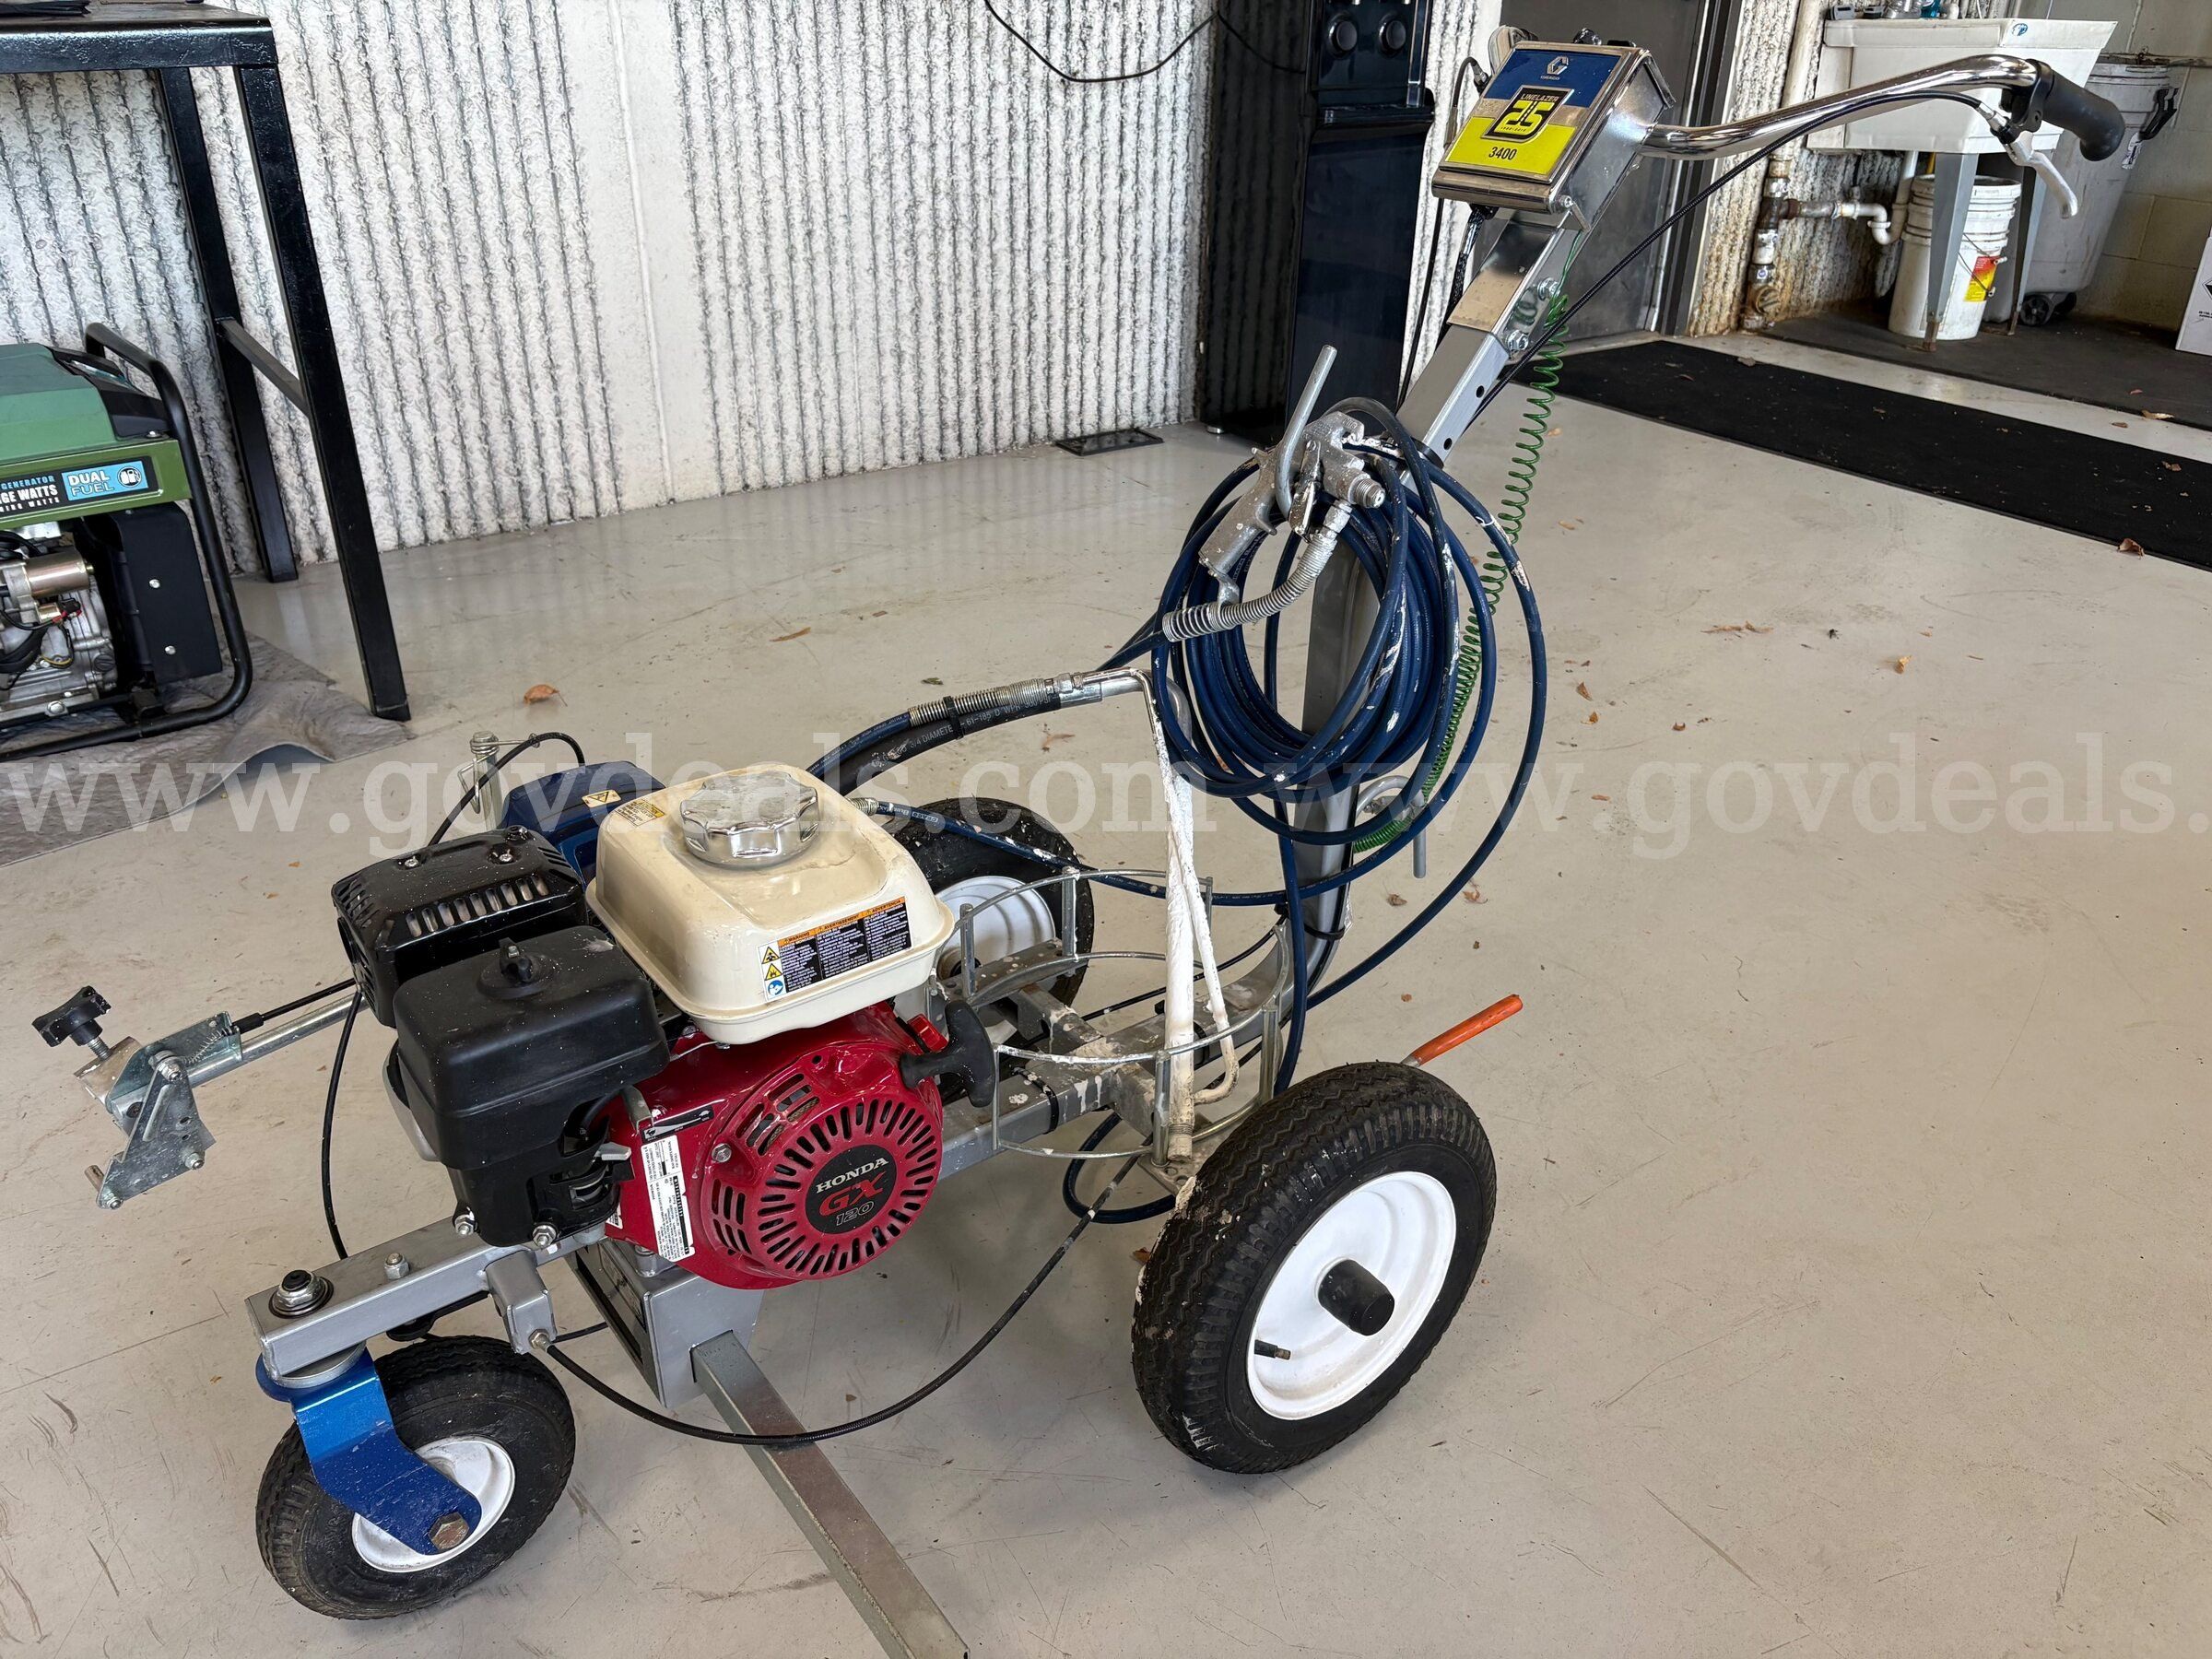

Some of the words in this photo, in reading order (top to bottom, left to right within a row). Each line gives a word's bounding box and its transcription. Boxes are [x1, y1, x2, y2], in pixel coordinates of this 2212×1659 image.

[1520, 93, 1560, 102] LINELAZER
[1488, 147, 1517, 161] 3400
[1, 475, 55, 490] GENERATOR
[67, 470, 110, 486] DUAL
[0, 491, 17, 504] GE
[17, 484, 58, 501] WATTS
[71, 482, 114, 497] FUEL
[912, 811, 939, 823] GRACO
[816, 1158, 888, 1194] HONDA
[819, 1171, 887, 1217] GX
[836, 1201, 875, 1226] 120
